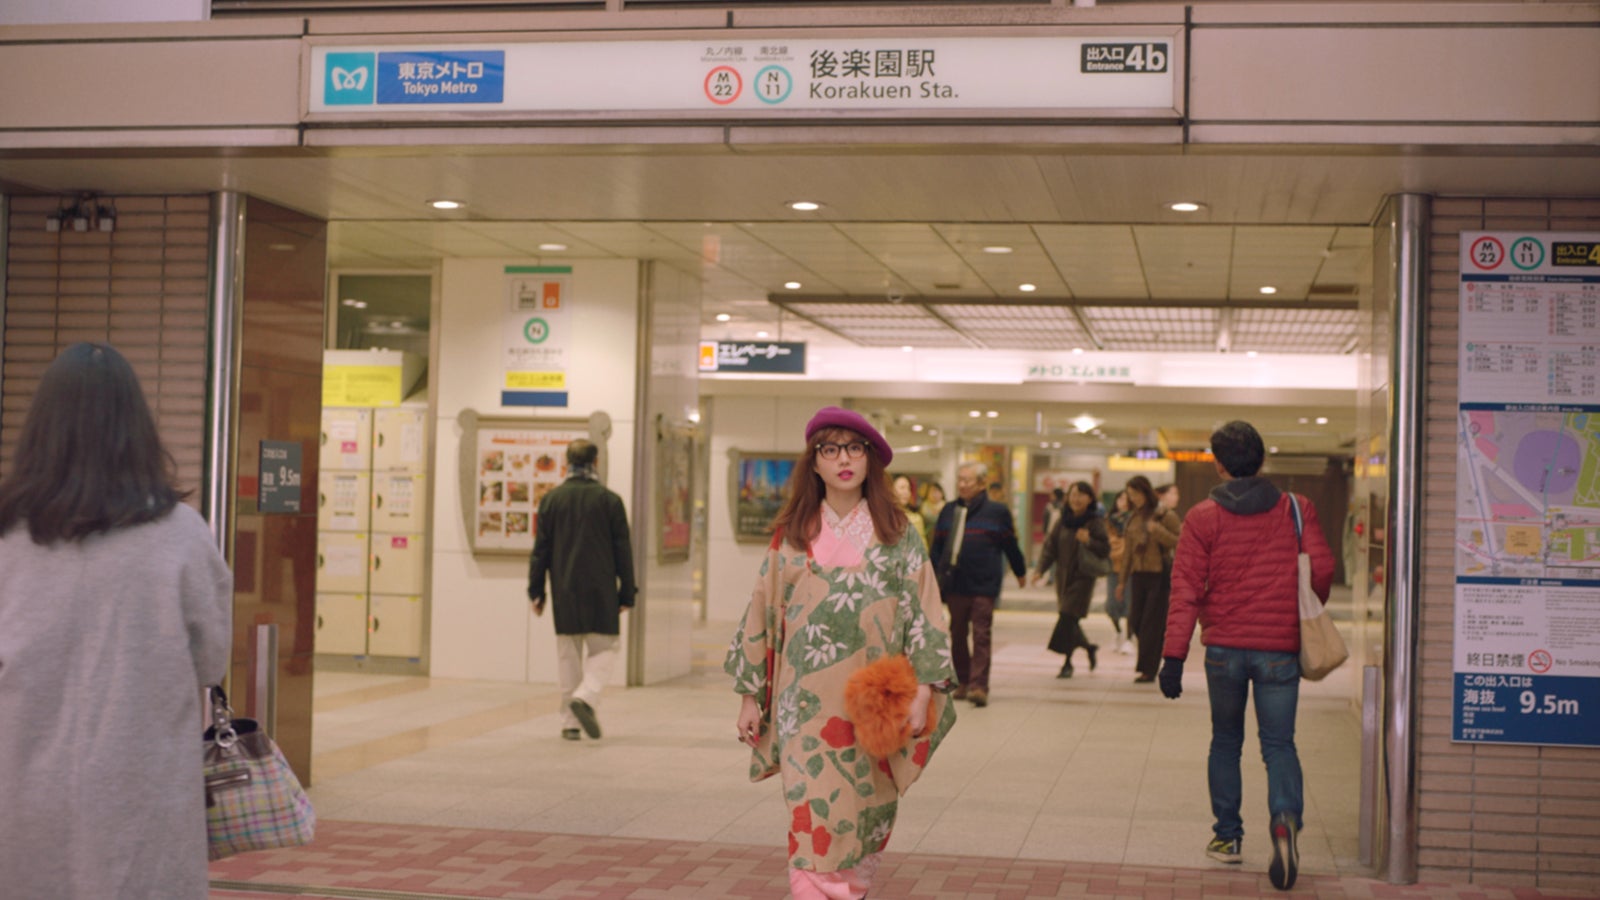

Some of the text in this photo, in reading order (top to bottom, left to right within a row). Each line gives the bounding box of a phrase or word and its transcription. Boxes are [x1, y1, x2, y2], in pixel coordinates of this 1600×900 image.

[1087, 46, 1124, 61] 出入口
[1125, 44, 1166, 71] 4b
[398, 62, 484, 80] 東京メトロ
[809, 49, 935, 78] 後楽園駅
[1087, 61, 1125, 71] Entrance
[717, 72, 730, 82] M
[768, 72, 779, 82] N
[403, 82, 478, 97] Tokyo Metro
[714, 84, 732, 96] 22
[765, 84, 780, 95] 11
[809, 81, 959, 99] Korakuen Sta.
[1479, 252, 1496, 263] 22
[1520, 252, 1535, 263] 11
[1556, 245, 1587, 256] 出入口
[720, 343, 791, 359] エレベーター
[1466, 652, 1525, 668] 終日禁煙
[1463, 675, 1533, 688] この出入口は
[1462, 689, 1496, 705] 海抜
[1519, 690, 1579, 715] 9.5m
